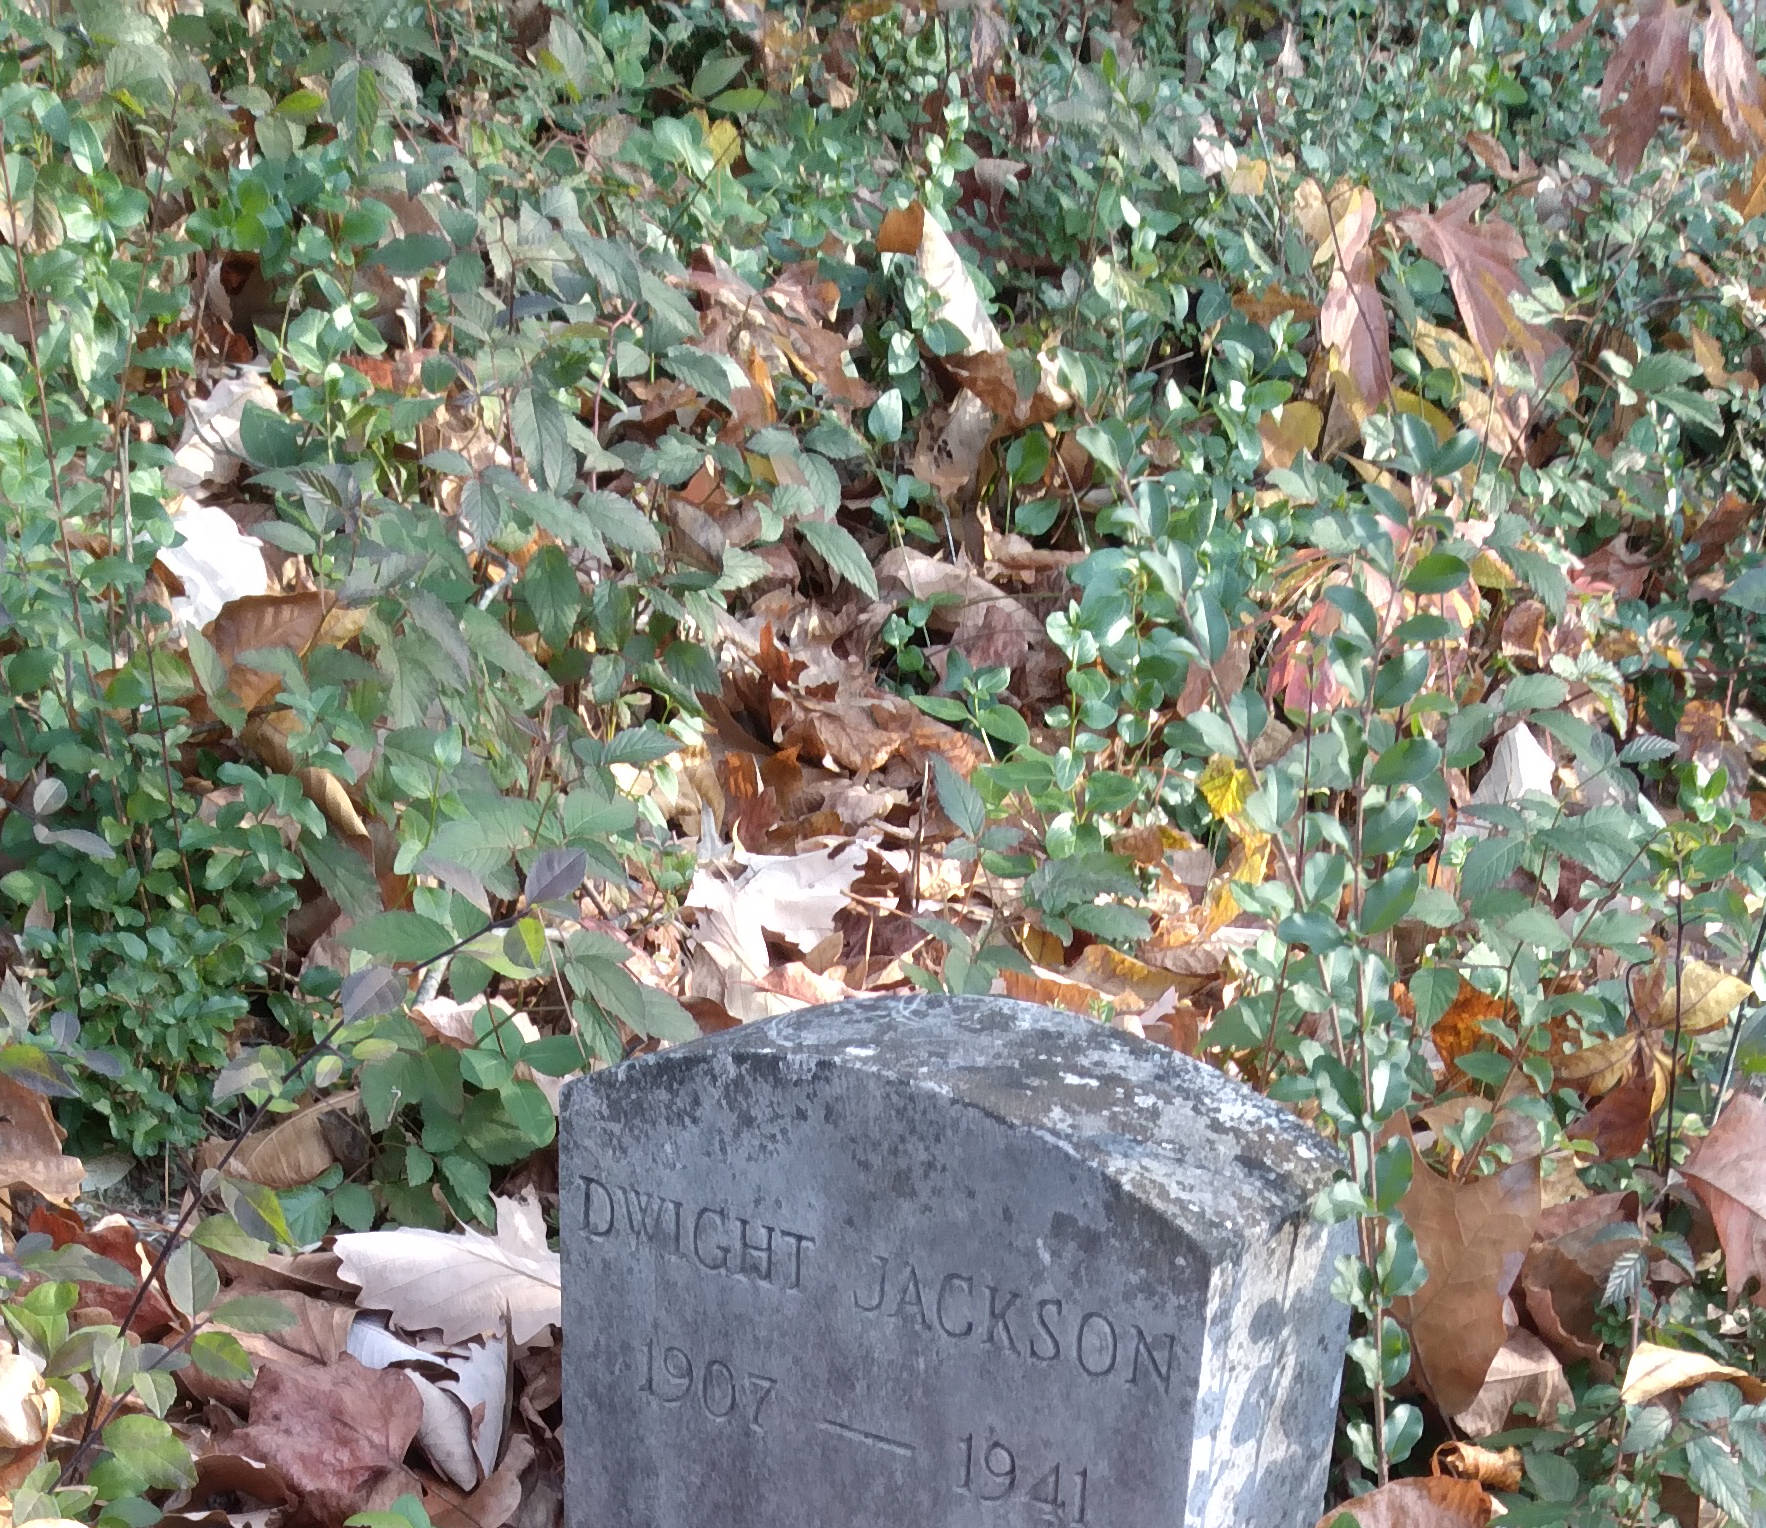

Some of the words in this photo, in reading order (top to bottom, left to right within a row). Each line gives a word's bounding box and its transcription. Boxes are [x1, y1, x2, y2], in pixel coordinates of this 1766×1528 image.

[578, 1174, 816, 1292] DWIGHT
[852, 1255, 1178, 1394] JACKSON
[637, 1337, 777, 1432] 1907
[954, 1432, 1088, 1528] 1941
